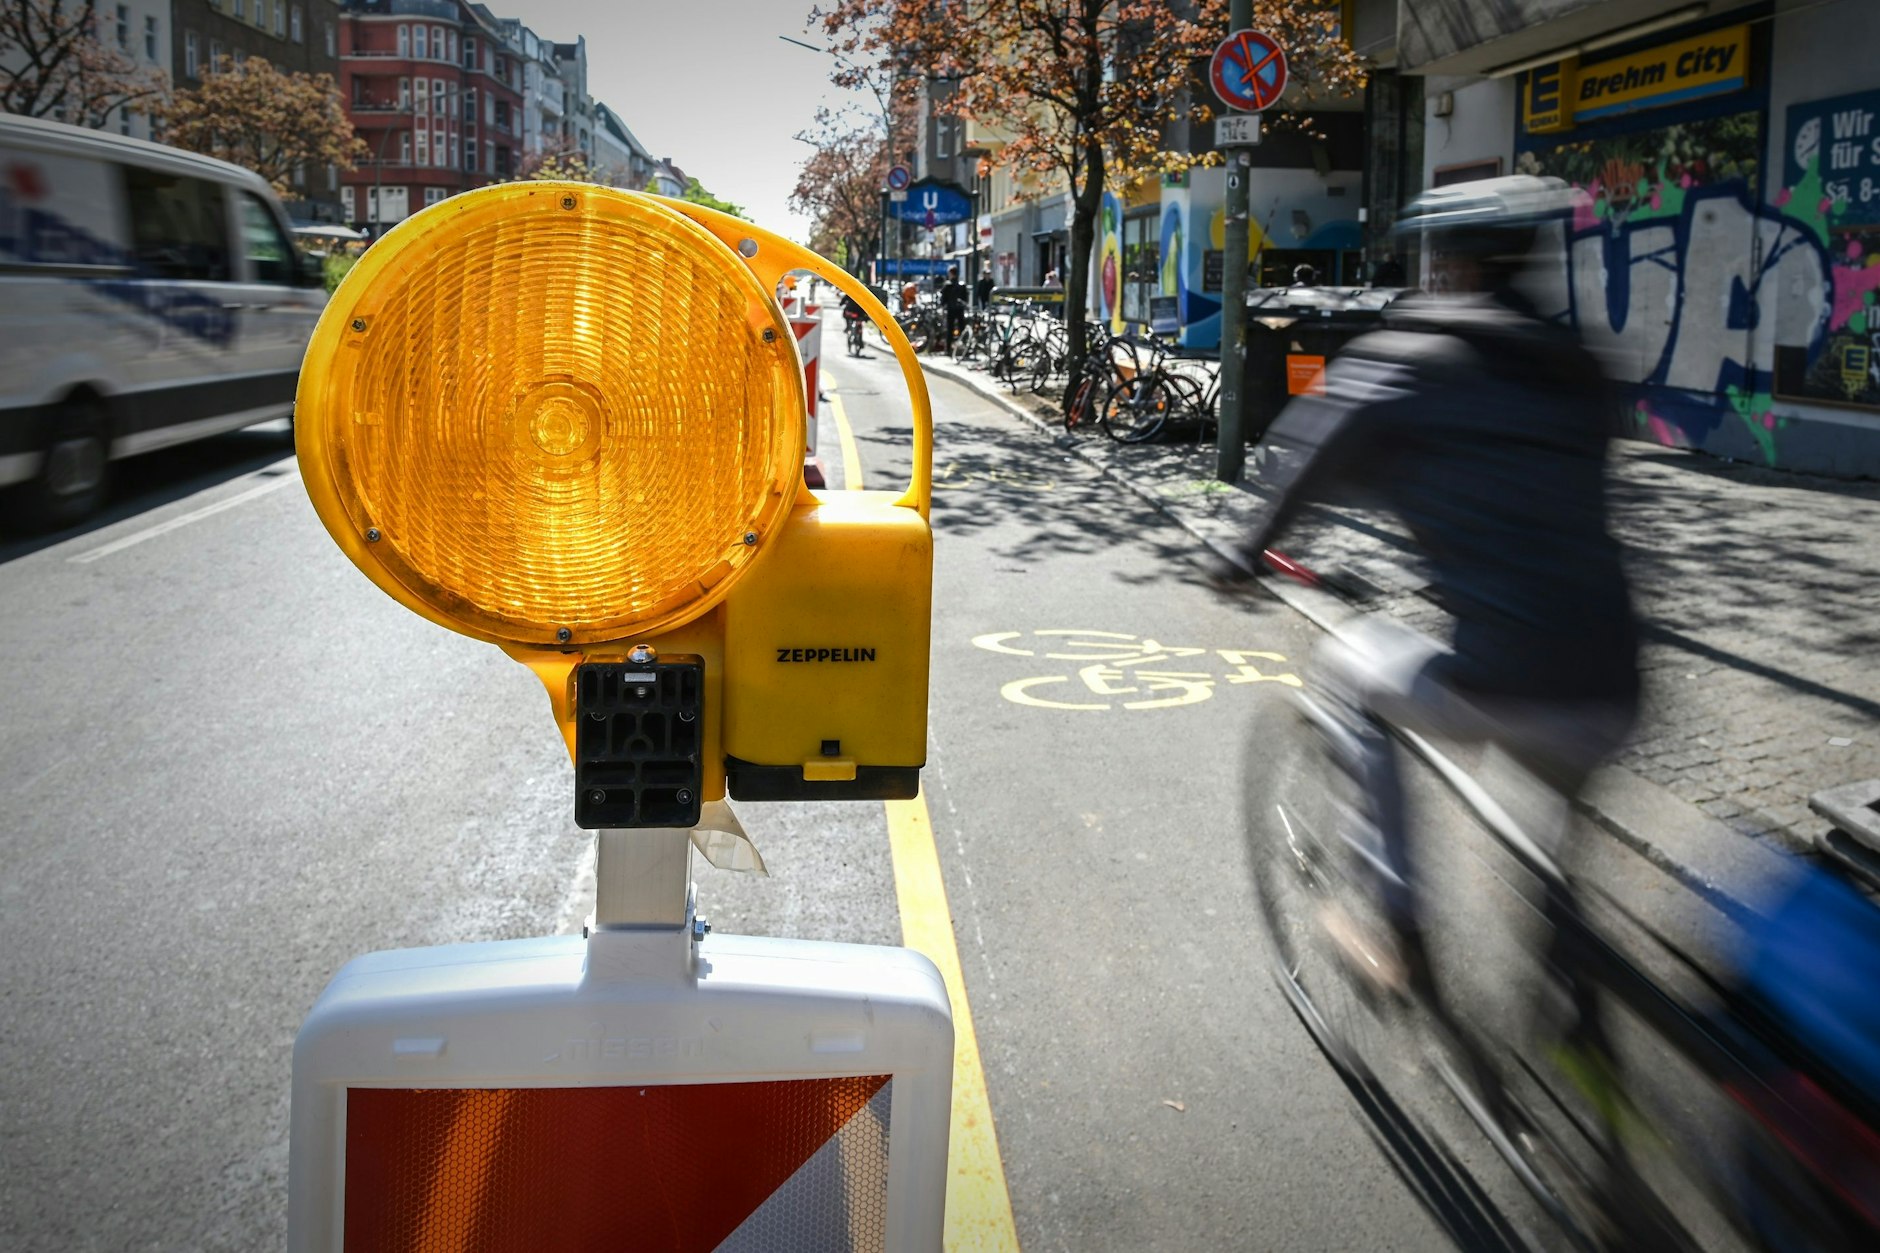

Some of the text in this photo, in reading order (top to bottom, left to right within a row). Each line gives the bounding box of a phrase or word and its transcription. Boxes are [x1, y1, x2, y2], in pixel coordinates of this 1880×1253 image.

[1579, 43, 1738, 101] Brehm City
[1531, 62, 1560, 114] E
[1832, 109, 1874, 139] Wir
[1830, 142, 1865, 170] für
[923, 191, 938, 209] U
[1859, 177, 1880, 202] 8-
[776, 648, 876, 662] ZEPPELIN
